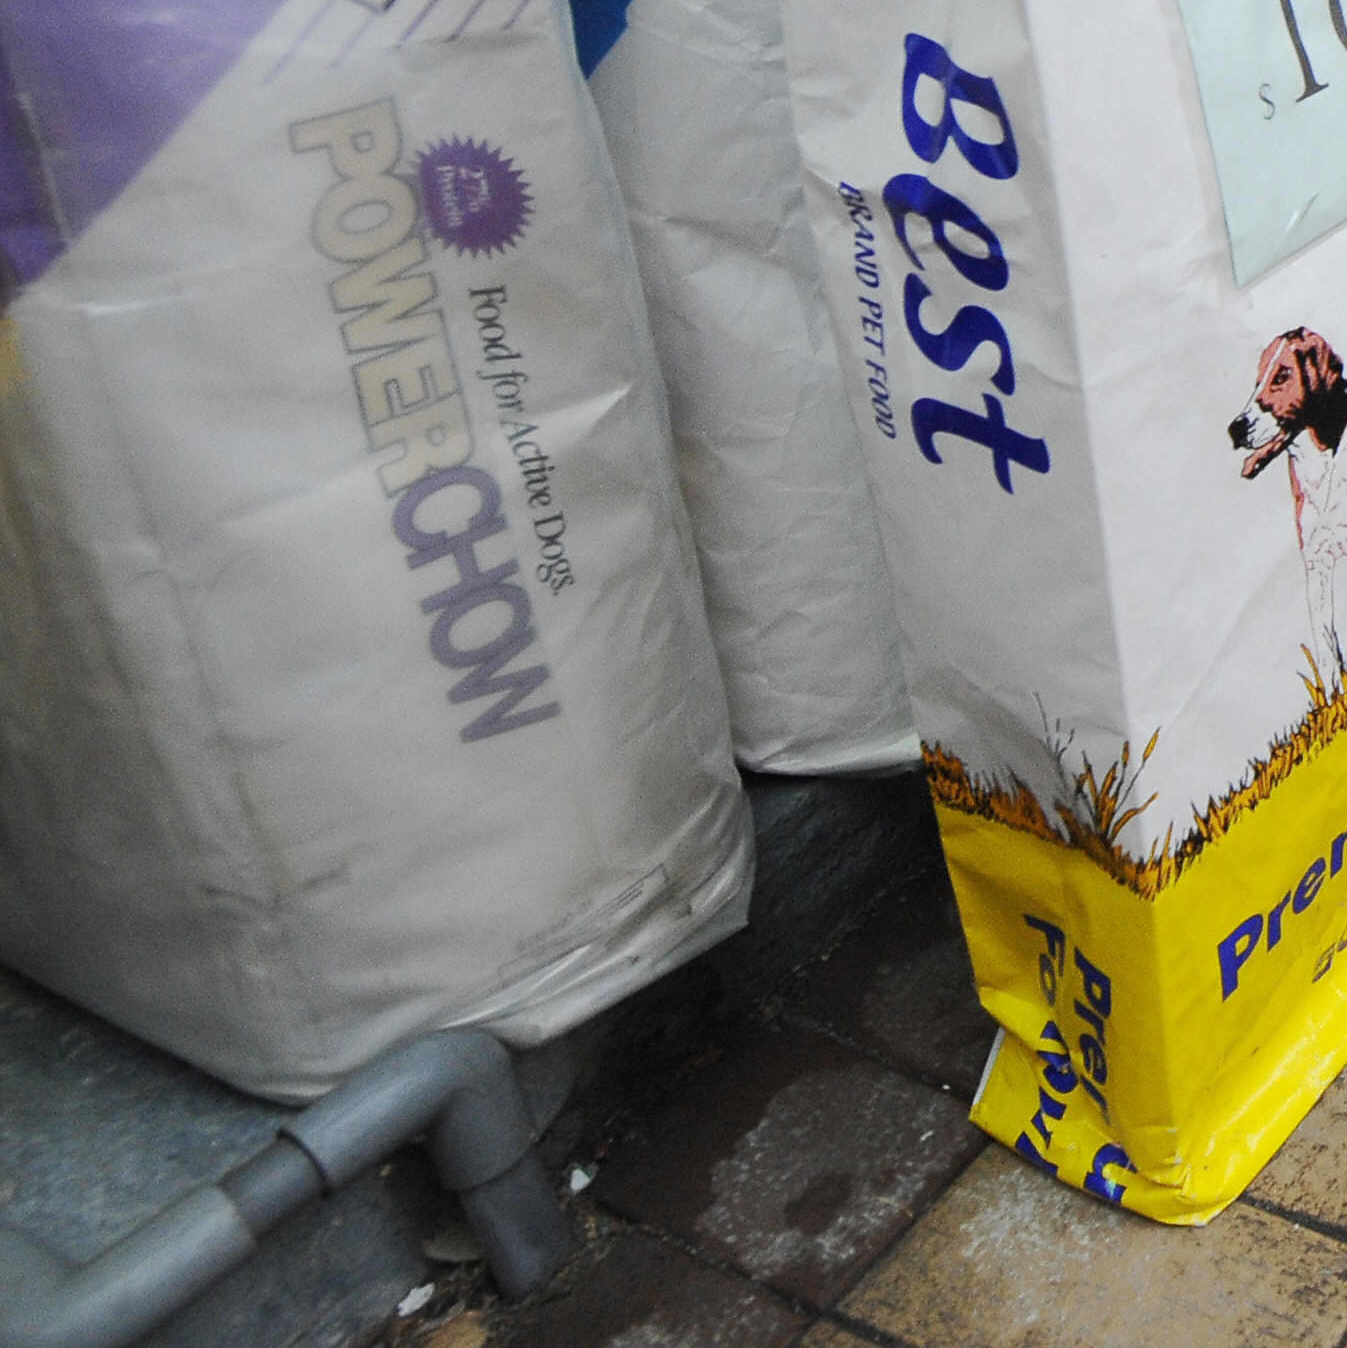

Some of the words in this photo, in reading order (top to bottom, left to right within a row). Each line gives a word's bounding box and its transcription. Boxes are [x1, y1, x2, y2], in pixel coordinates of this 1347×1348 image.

[837, 181, 882, 289] BRAND
[881, 32, 1052, 496] Best
[466, 284, 512, 367] Food
[857, 296, 887, 357] PET
[488, 370, 526, 420] for
[865, 358, 897, 441] FOOD
[500, 416, 555, 507] Active
[530, 510, 582, 596] Dogs.
